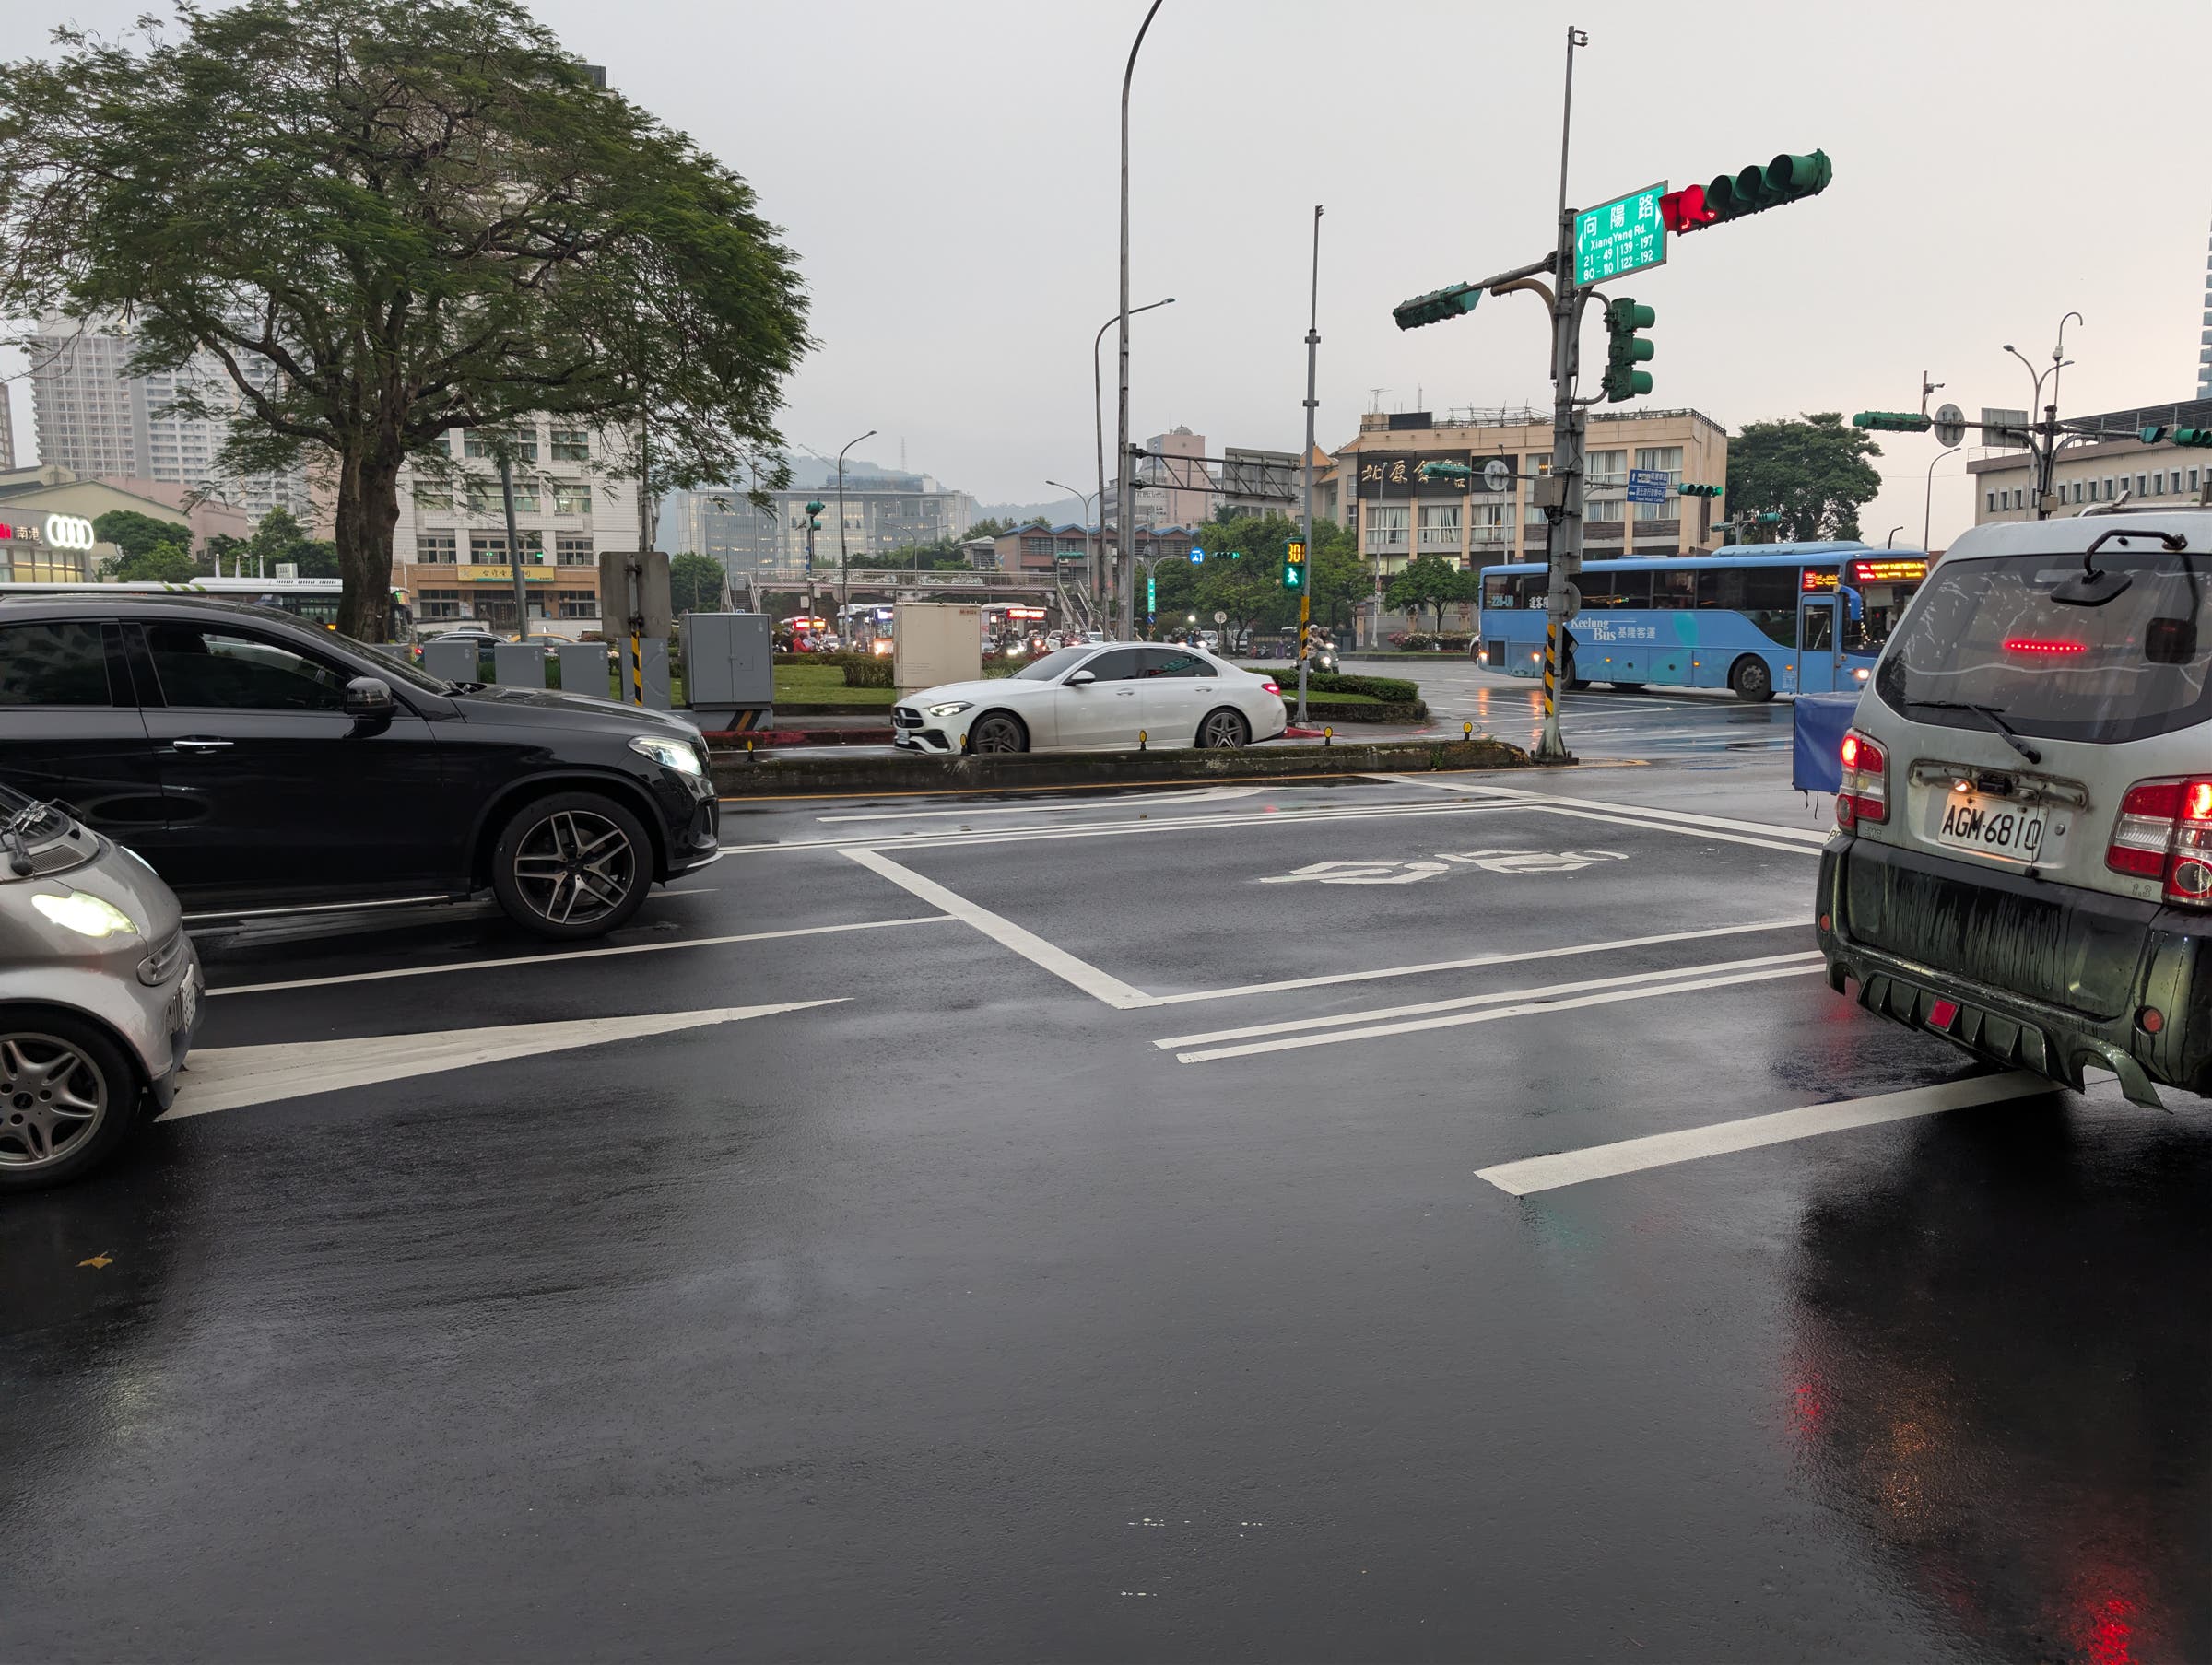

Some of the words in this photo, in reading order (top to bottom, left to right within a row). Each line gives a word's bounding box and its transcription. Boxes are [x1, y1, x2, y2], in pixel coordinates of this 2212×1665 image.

[1583, 193, 1653, 240] 向陽路
[1620, 241, 1633, 255] 139
[1641, 234, 1653, 249] 197
[1583, 253, 1594, 268] 21
[1603, 248, 1613, 260] 49
[1620, 256, 1633, 269] 122
[1641, 250, 1653, 263] 192
[1583, 270, 1594, 281] 80
[16, 526, 40, 541] 南港
[1571, 617, 1609, 630] Keelung
[1594, 628, 1617, 641] Bus
[1618, 627, 1656, 639] 基隆客運
[1942, 804, 2042, 850] AGM-6810
[2132, 882, 2153, 898] 1.3
